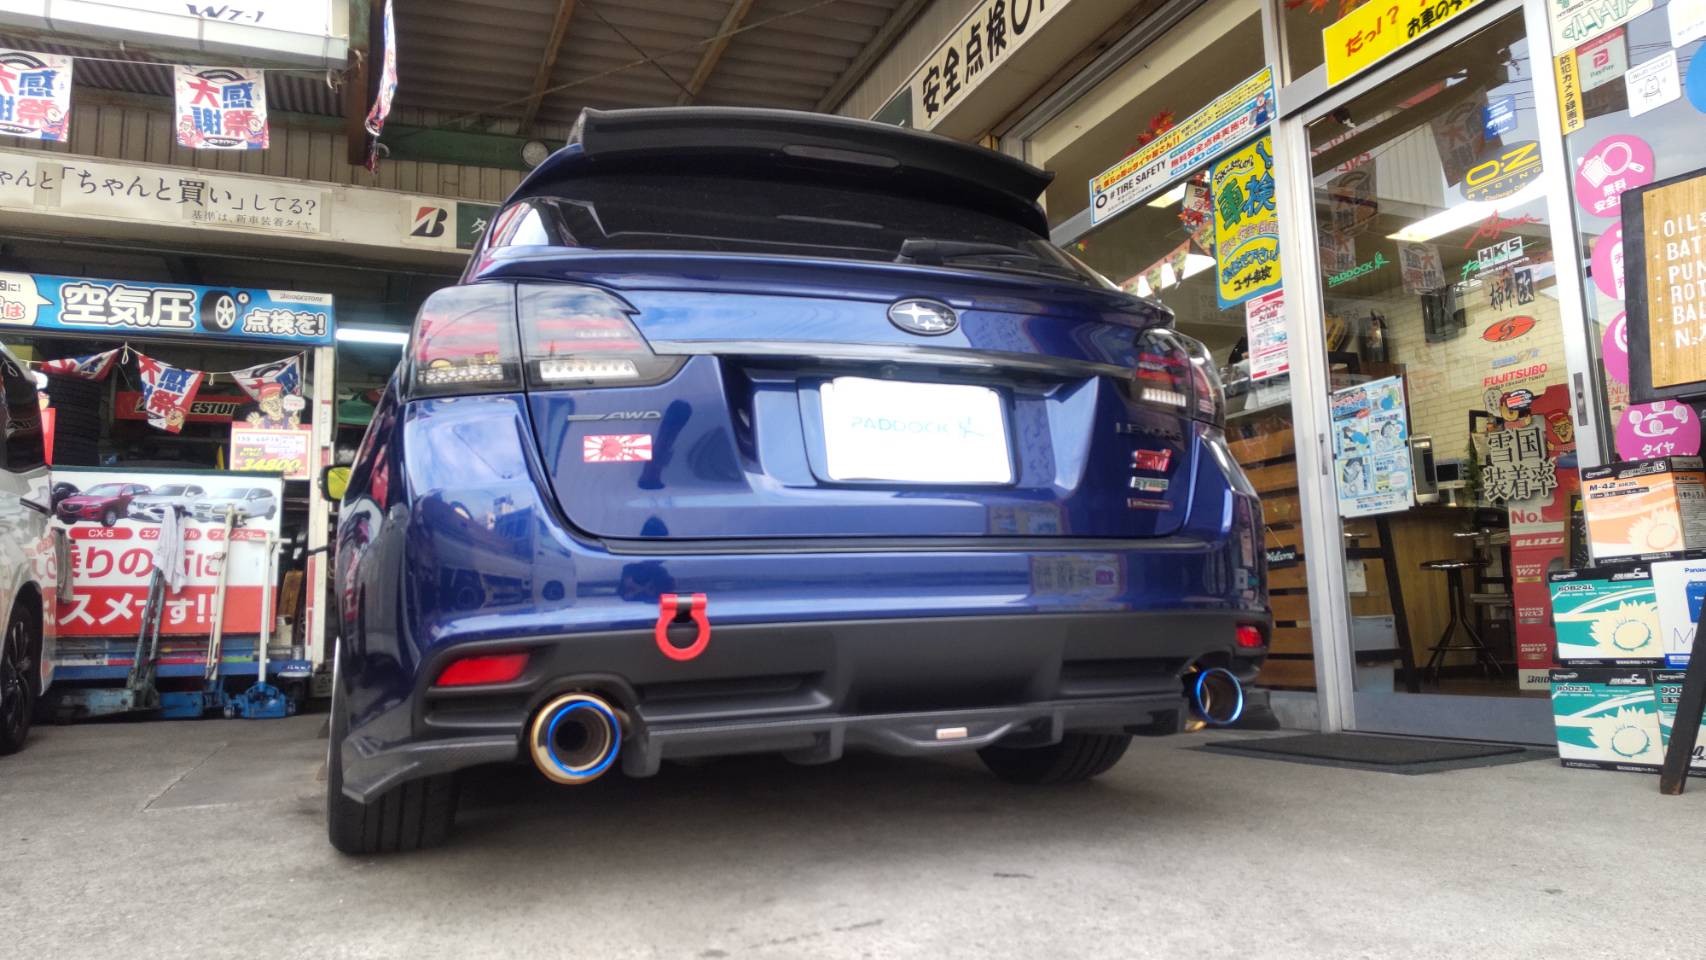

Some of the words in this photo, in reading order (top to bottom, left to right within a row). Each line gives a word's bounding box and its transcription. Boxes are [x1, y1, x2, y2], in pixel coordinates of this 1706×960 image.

[1594, 194, 1621, 213] 安全
[1479, 235, 1522, 265] HKS
[62, 284, 195, 327] 空気圧
[1484, 363, 1548, 387] FUJITSUBO
[603, 410, 661, 420] AWD
[1488, 427, 1545, 463] 雪国
[1642, 441, 1675, 455] タイヤ
[1484, 462, 1557, 499] 装着率
[1589, 482, 1616, 491] M-42
[88, 529, 114, 538] CX-5
